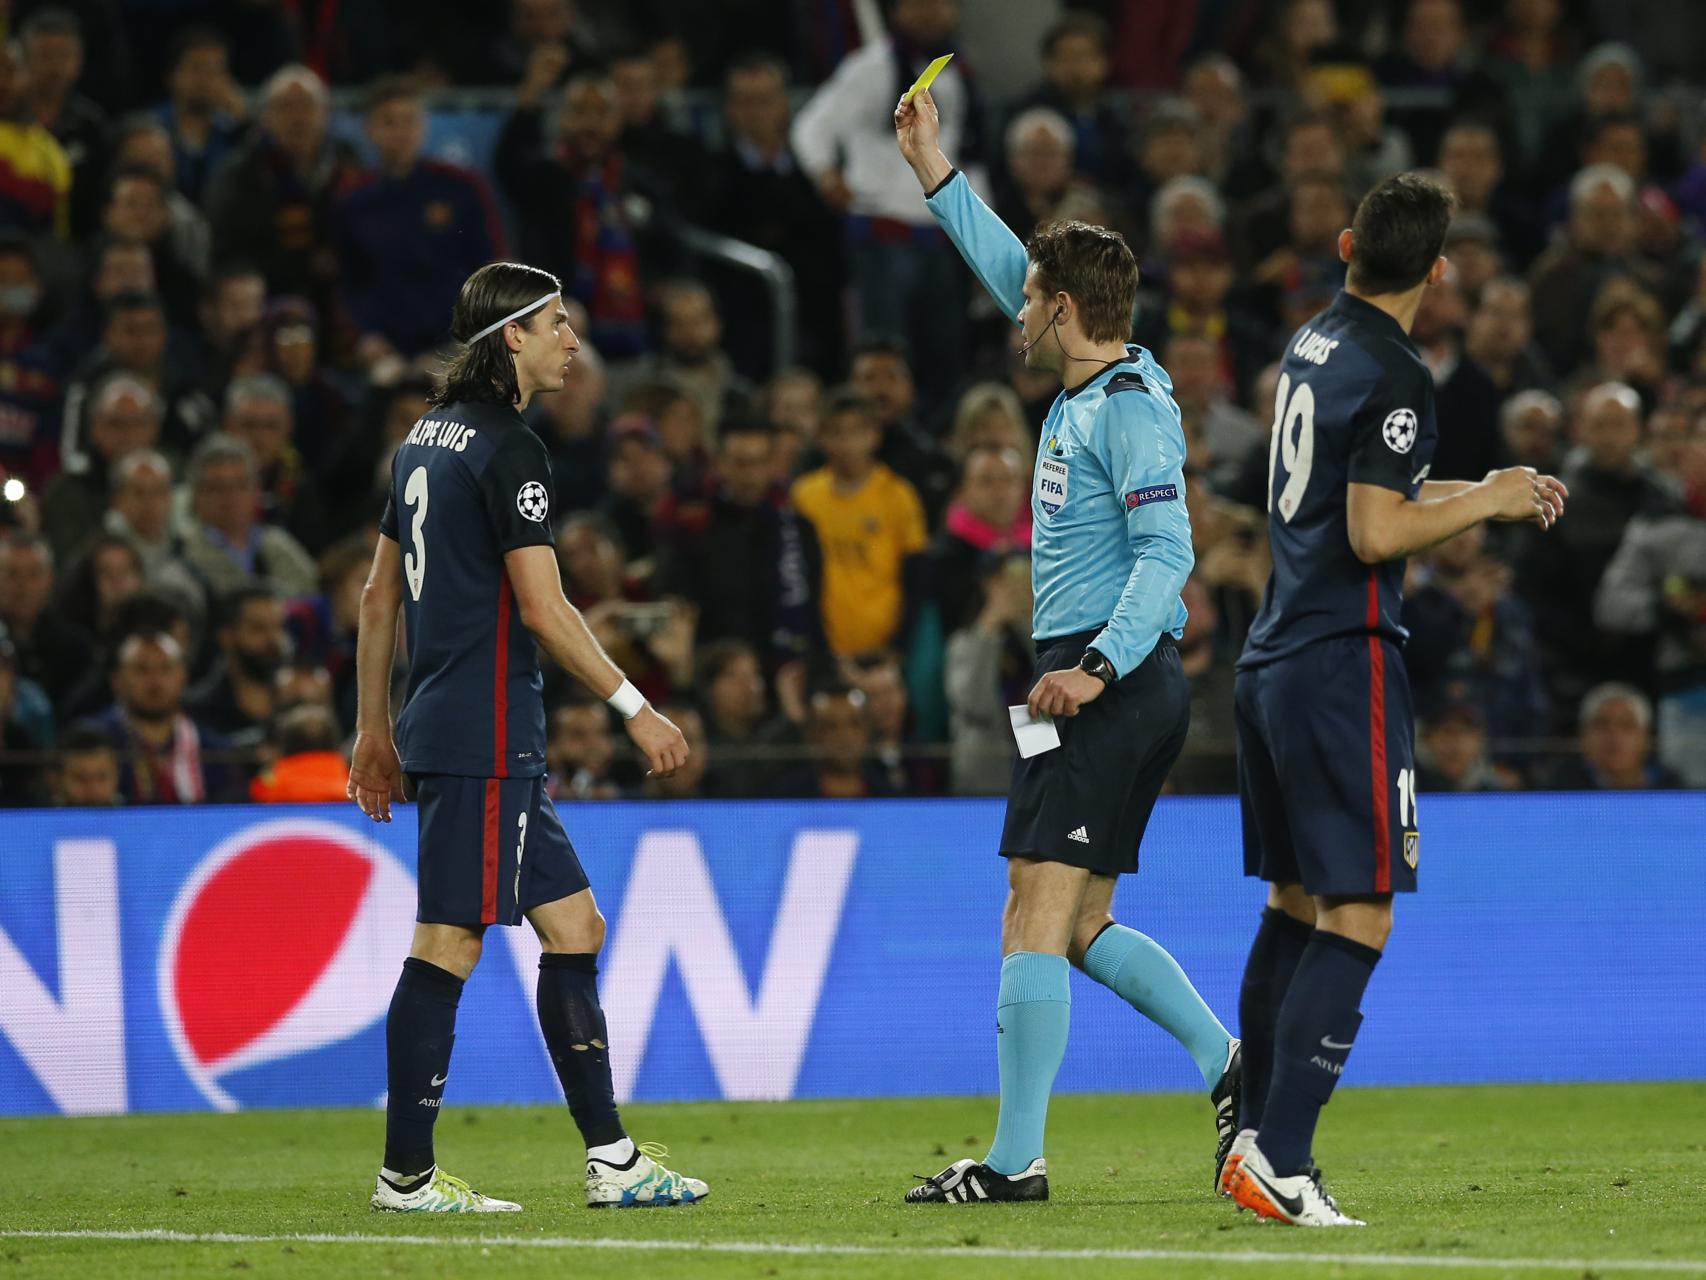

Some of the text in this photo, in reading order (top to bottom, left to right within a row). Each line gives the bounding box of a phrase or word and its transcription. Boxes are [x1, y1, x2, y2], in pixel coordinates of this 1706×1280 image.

[436, 421, 477, 452] LUIS
[1267, 372, 1315, 524] 19
[1042, 461, 1066, 476] REFEREE
[1041, 478, 1063, 496] FIFA
[1138, 488, 1176, 501] RESPECT
[404, 465, 428, 602] 3
[515, 811, 528, 865] 3
